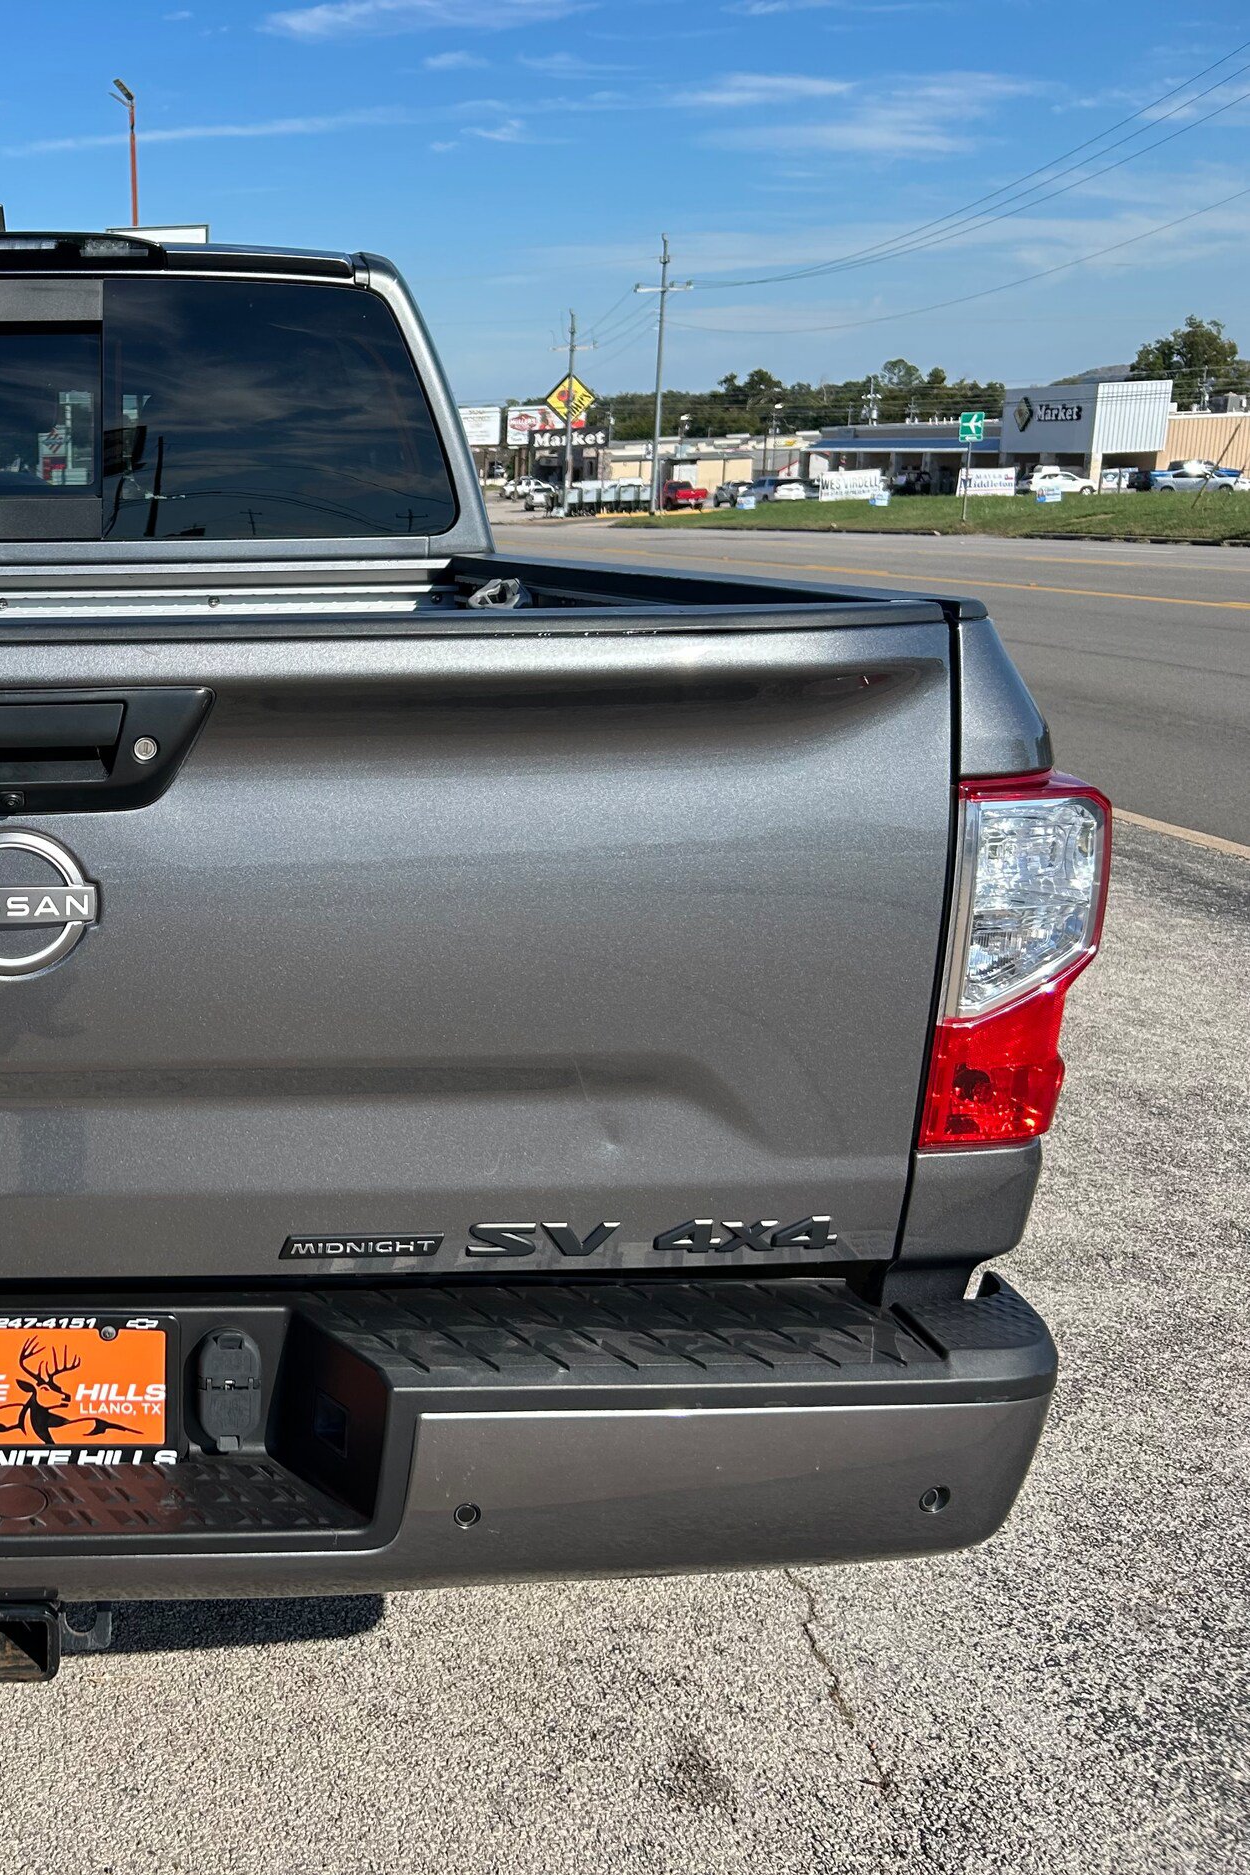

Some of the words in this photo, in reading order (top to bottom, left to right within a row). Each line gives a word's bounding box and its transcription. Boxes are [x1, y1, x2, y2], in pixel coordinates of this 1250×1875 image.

[1036, 404, 1080, 421] Market
[821, 478, 841, 490] WES
[844, 475, 878, 489] VIRDELL
[465, 1222, 621, 1257] SV
[653, 1215, 838, 1253] 4X4
[291, 1240, 435, 1255] MIDNIGHT
[75, 1384, 166, 1401] HILLS
[79, 1402, 137, 1416] LLANO,
[141, 1402, 161, 1414] TX
[77, 1449, 178, 1466] HILLS
